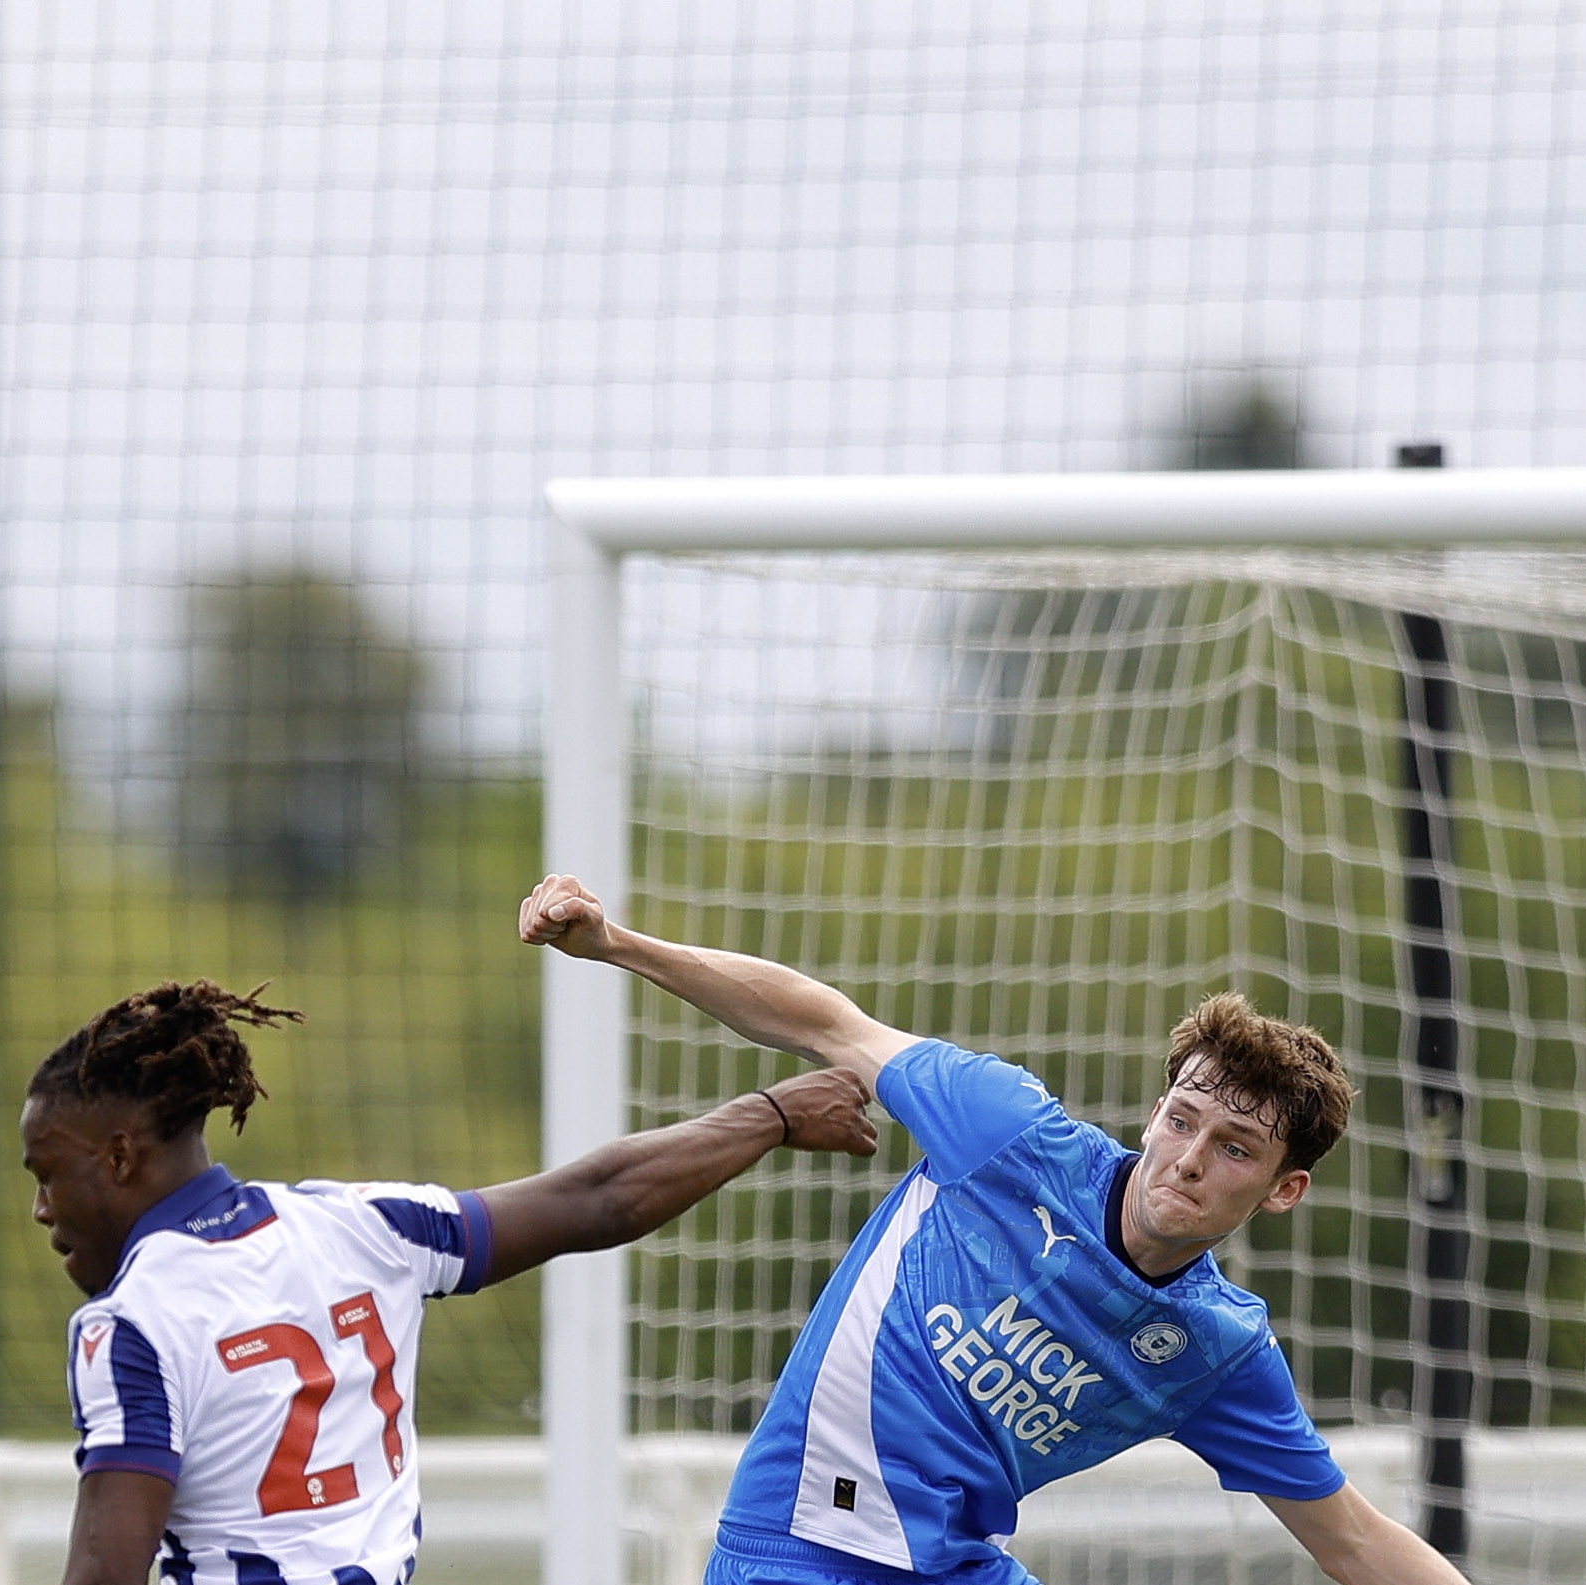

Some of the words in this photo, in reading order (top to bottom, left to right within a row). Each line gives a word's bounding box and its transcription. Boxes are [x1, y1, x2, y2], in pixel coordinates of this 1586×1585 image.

[216, 1290, 404, 1516] 21
[925, 1303, 1082, 1457] GEORGE
[981, 1294, 1104, 1411] MICK
